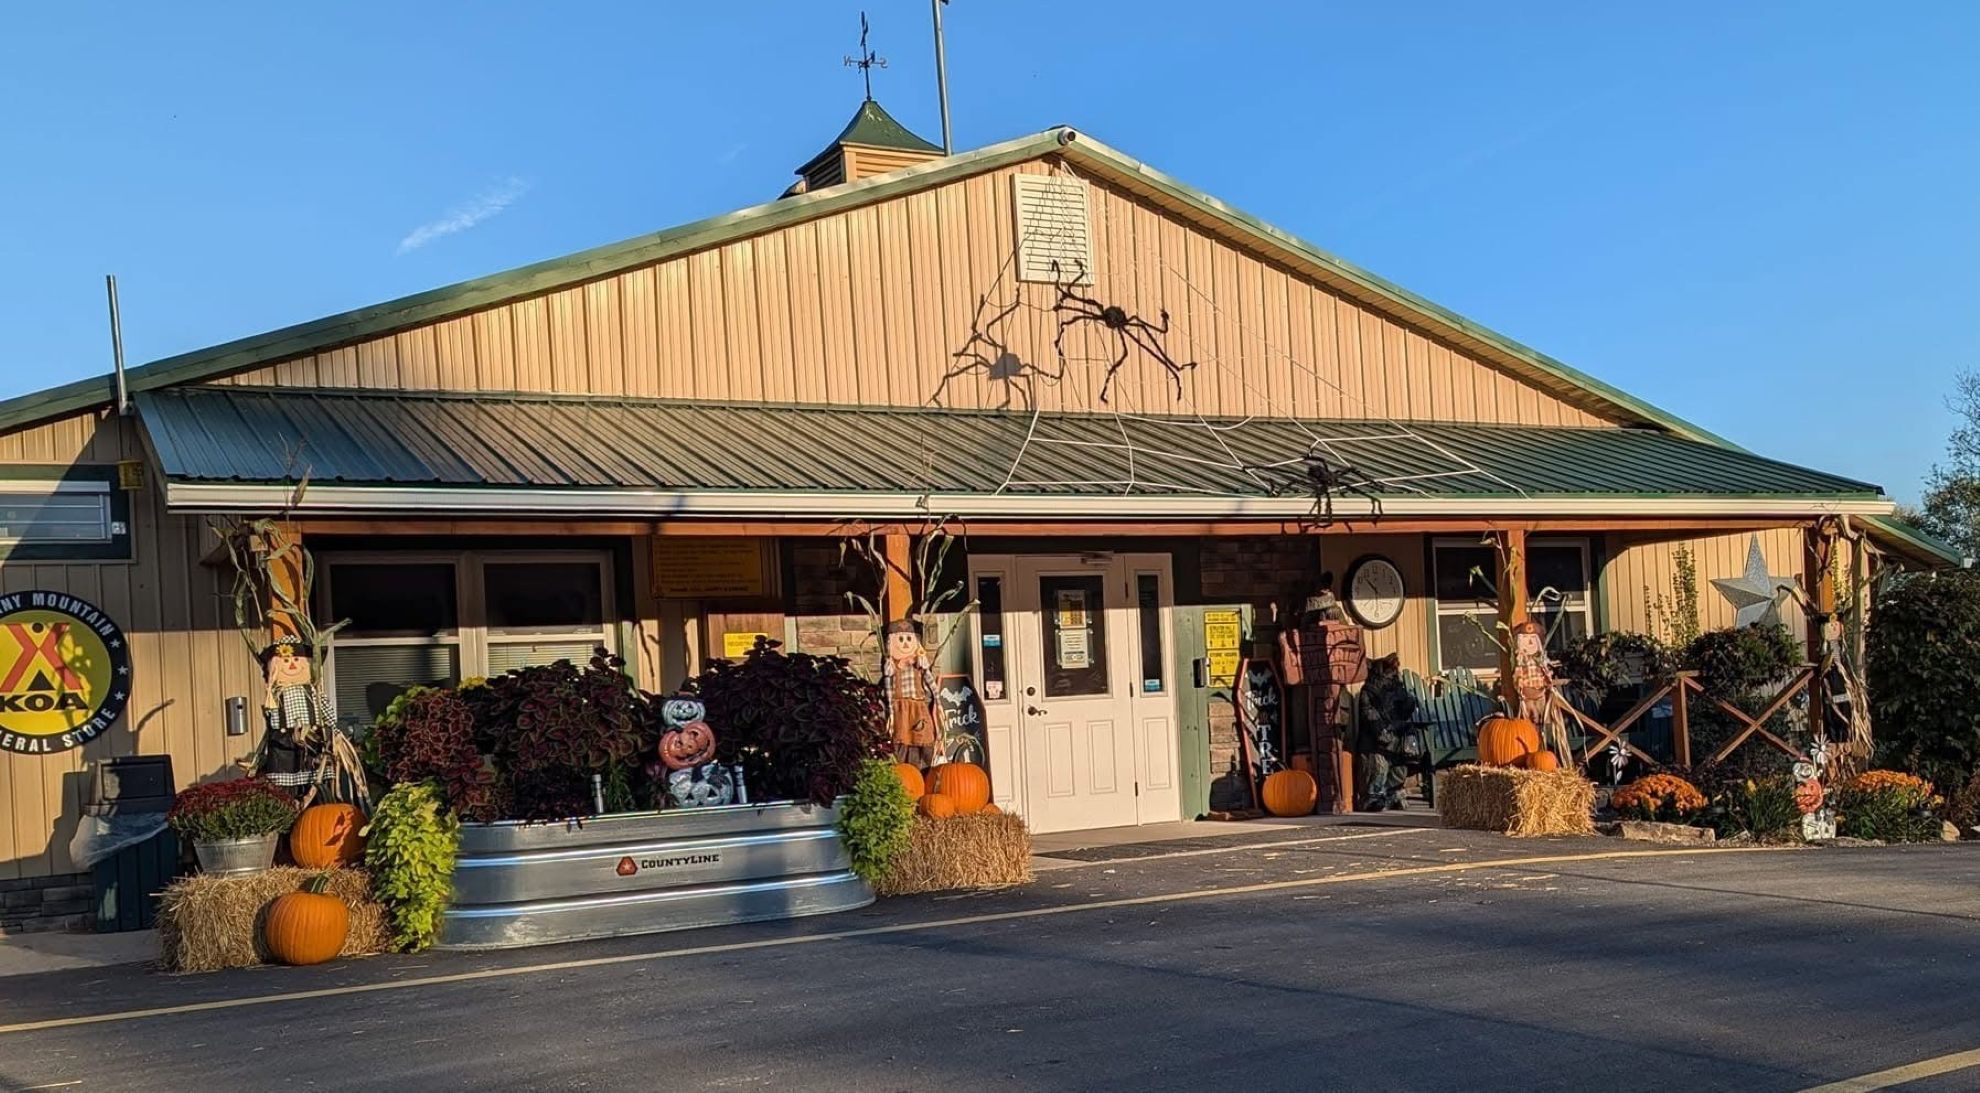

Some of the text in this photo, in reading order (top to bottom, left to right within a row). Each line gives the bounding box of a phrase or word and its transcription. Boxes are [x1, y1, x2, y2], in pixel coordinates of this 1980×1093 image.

[0, 592, 115, 637] NY MOUNTAIN
[0, 692, 89, 712] KOA
[944, 704, 980, 731] Trick
[0, 708, 116, 752] ERAL STORE
